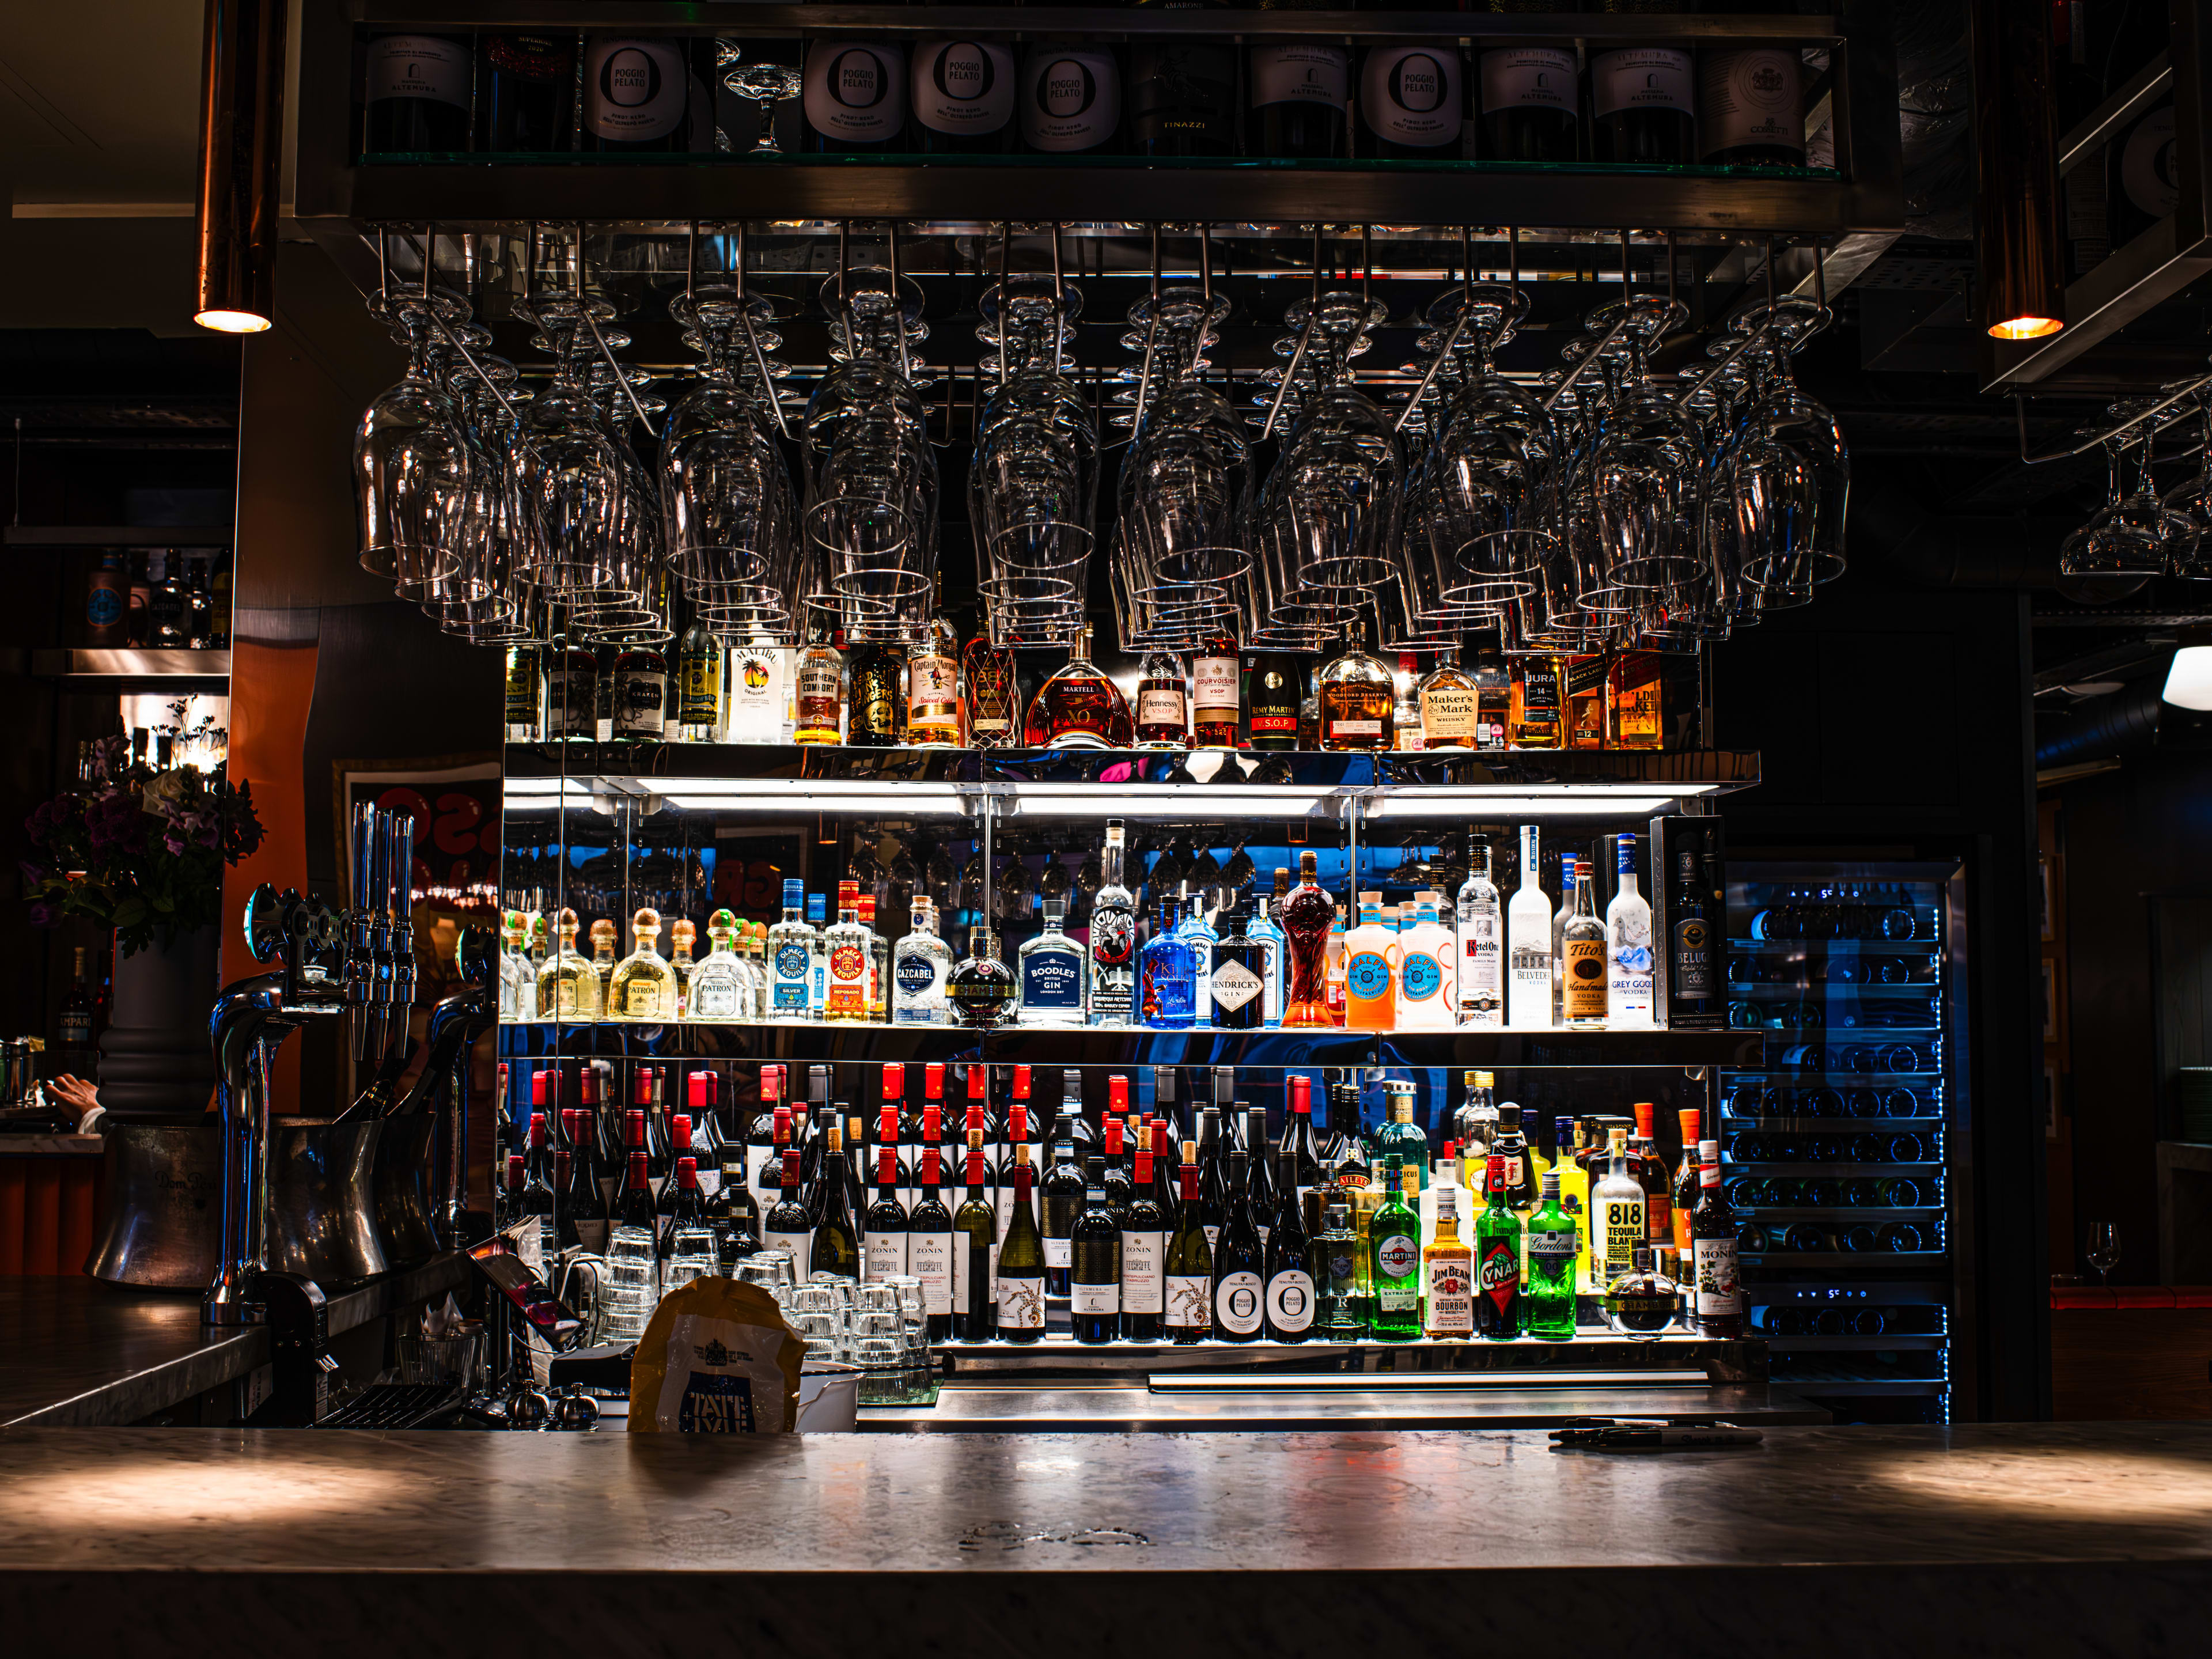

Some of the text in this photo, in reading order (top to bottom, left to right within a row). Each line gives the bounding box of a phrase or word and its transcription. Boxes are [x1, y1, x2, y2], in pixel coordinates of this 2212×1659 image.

[949, 62, 979, 71] POGGIO
[615, 70, 645, 78] POGGIO
[843, 69, 873, 78] POGGIO
[949, 71, 979, 81] PELATO
[615, 79, 645, 88] PELATO
[843, 78, 873, 88] PELATO
[1051, 79, 1080, 89] POGGIO
[1405, 74, 1434, 84] POGGIO
[392, 85, 436, 93] ALTEMURA
[1290, 88, 1332, 98] ALTEMURA
[1405, 84, 1434, 93] PELATO
[1051, 89, 1081, 99] PELATO
[1521, 93, 1562, 102] ALTEMURA
[1162, 120, 1206, 129] TINAZZI
[1750, 126, 1788, 135] COSSETTI
[736, 648, 778, 664] MALIBU
[914, 658, 956, 672] Captain Morgan
[1622, 666, 1635, 676] RED
[801, 673, 836, 684] SOUTHERN
[853, 671, 873, 690] DEAD
[1525, 675, 1556, 683] JURA
[1569, 672, 1587, 682] BLACK
[744, 688, 767, 696] ORIGINAL
[803, 683, 834, 692] COMFORT
[856, 688, 893, 709] FINGERS
[919, 696, 953, 704] Spiced Gold
[1427, 695, 1473, 704] Maker's
[1146, 699, 1178, 709] Hennessy
[1269, 704, 1294, 714] MARTIN
[1440, 704, 1472, 713] Mark
[1067, 709, 1090, 724] XO
[1467, 940, 1499, 956] Ketel One
[1570, 942, 1605, 956] Tito's
[780, 948, 805, 960] OLMECA
[835, 949, 860, 961] OLMECA
[1161, 963, 1190, 975] King
[1351, 956, 1385, 972] MALFY
[1404, 956, 1436, 972] MALFY
[779, 965, 806, 977] TEQUILA
[834, 966, 861, 978] TEQUILA
[897, 968, 933, 979] CAZCABEL
[1031, 967, 1075, 978] BOODLES
[1161, 974, 1191, 983] SOHO
[627, 984, 656, 994] PATRÓN
[702, 983, 732, 992] PATRÓN
[1211, 981, 1259, 989] HENDRICK'S
[1567, 982, 1608, 991] Handmade
[1612, 980, 1631, 988] GREY
[957, 986, 1012, 995] CHAMBORD
[1339, 1175, 1371, 1188] AILEYS
[1608, 1203, 1641, 1225] 818
[1608, 1227, 1642, 1236] TEQUILA
[1531, 1236, 1573, 1251] Gordon's
[1700, 1251, 1737, 1259] MONIN
[1432, 1266, 1471, 1283] JIM BEAM
[1480, 1257, 1519, 1290] CYNAR
[1338, 1298, 1349, 1308] R
[1435, 1302, 1468, 1310] BOURBON
[1622, 1301, 1676, 1309] CHAMBORD
[690, 1391, 747, 1419] TATE
